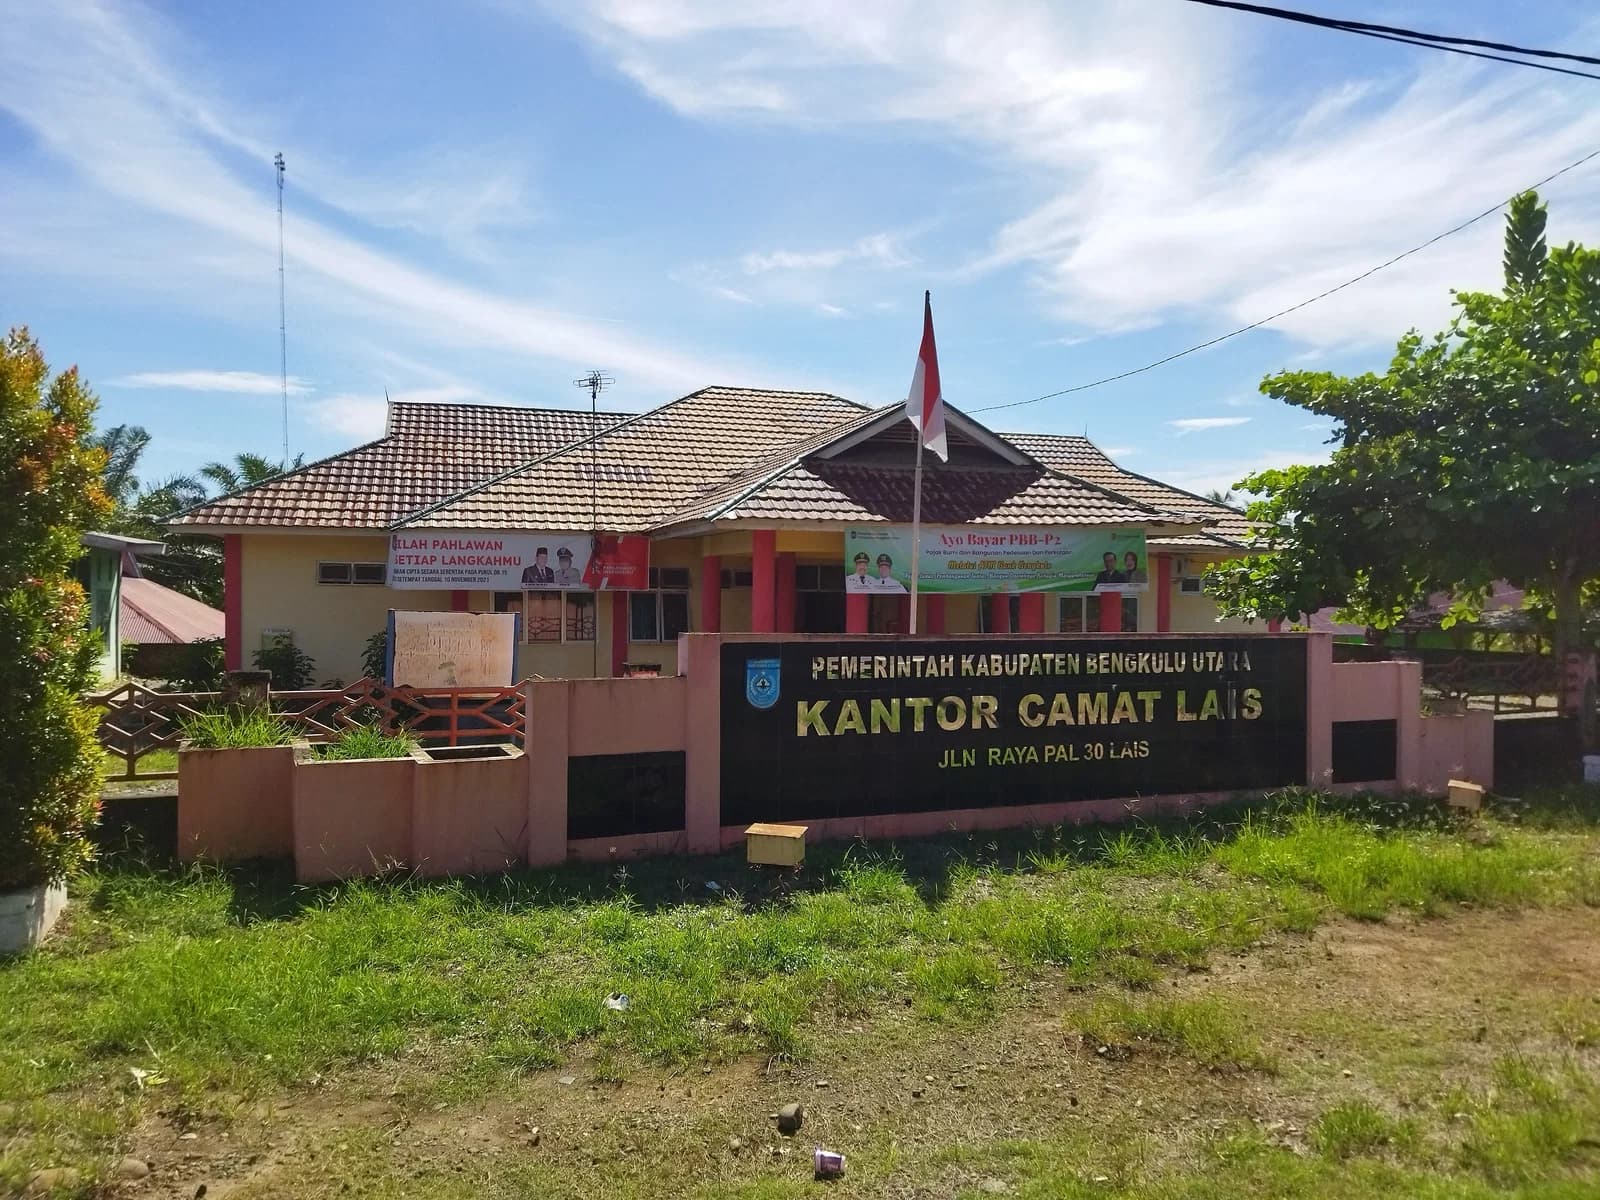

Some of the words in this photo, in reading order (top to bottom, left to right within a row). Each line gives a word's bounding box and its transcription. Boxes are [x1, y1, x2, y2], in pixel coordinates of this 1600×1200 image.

[432, 540, 503, 551] PAHLAWAN
[939, 533, 963, 548] Ayo
[967, 533, 1007, 548] Bayar
[1008, 533, 1062, 546] PBB-P2
[441, 555, 521, 567] LANGKAHMU
[926, 549, 942, 558] Pajak
[811, 654, 954, 681] PEMERINTAH
[960, 652, 1080, 677] KABUPATEN
[1086, 651, 1186, 675] BENGKULU
[1192, 650, 1251, 673] UTARA
[796, 694, 1000, 737] KANTOR
[1018, 688, 1162, 728] CAMAT
[1176, 687, 1264, 722] LAIS
[938, 748, 976, 769] JLN
[988, 746, 1039, 767] RAYA
[1044, 744, 1080, 763] PAL
[1083, 743, 1104, 760] 30
[1109, 740, 1150, 759] LAIS
